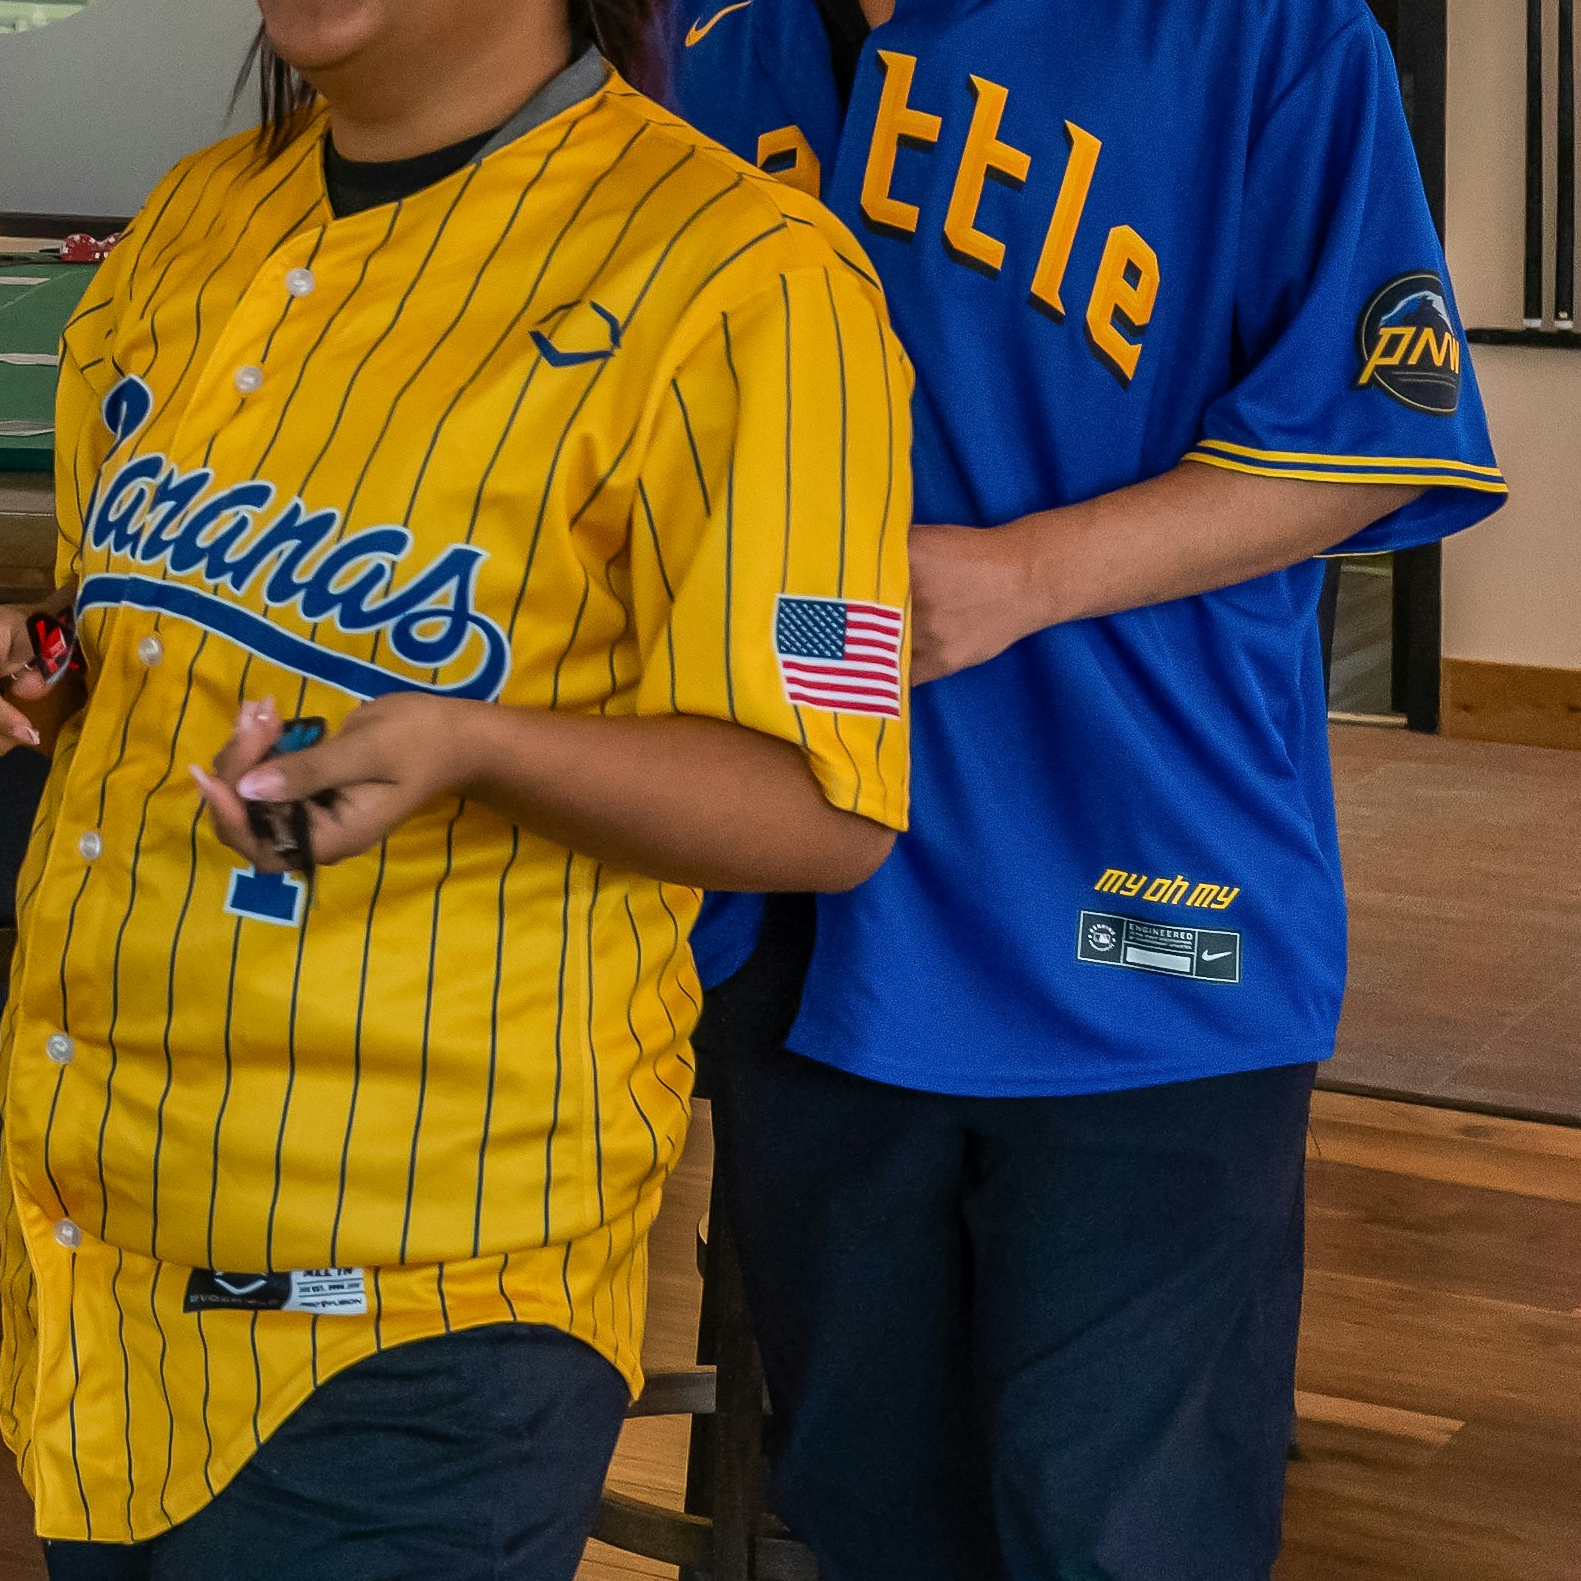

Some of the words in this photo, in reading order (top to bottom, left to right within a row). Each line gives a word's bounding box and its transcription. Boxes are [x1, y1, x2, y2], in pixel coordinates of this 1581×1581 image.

[1094, 868, 1148, 897] my
[1142, 875, 1190, 905] oh
[1185, 883, 1241, 910] my
[1129, 922, 1194, 940] ENGINEERED
